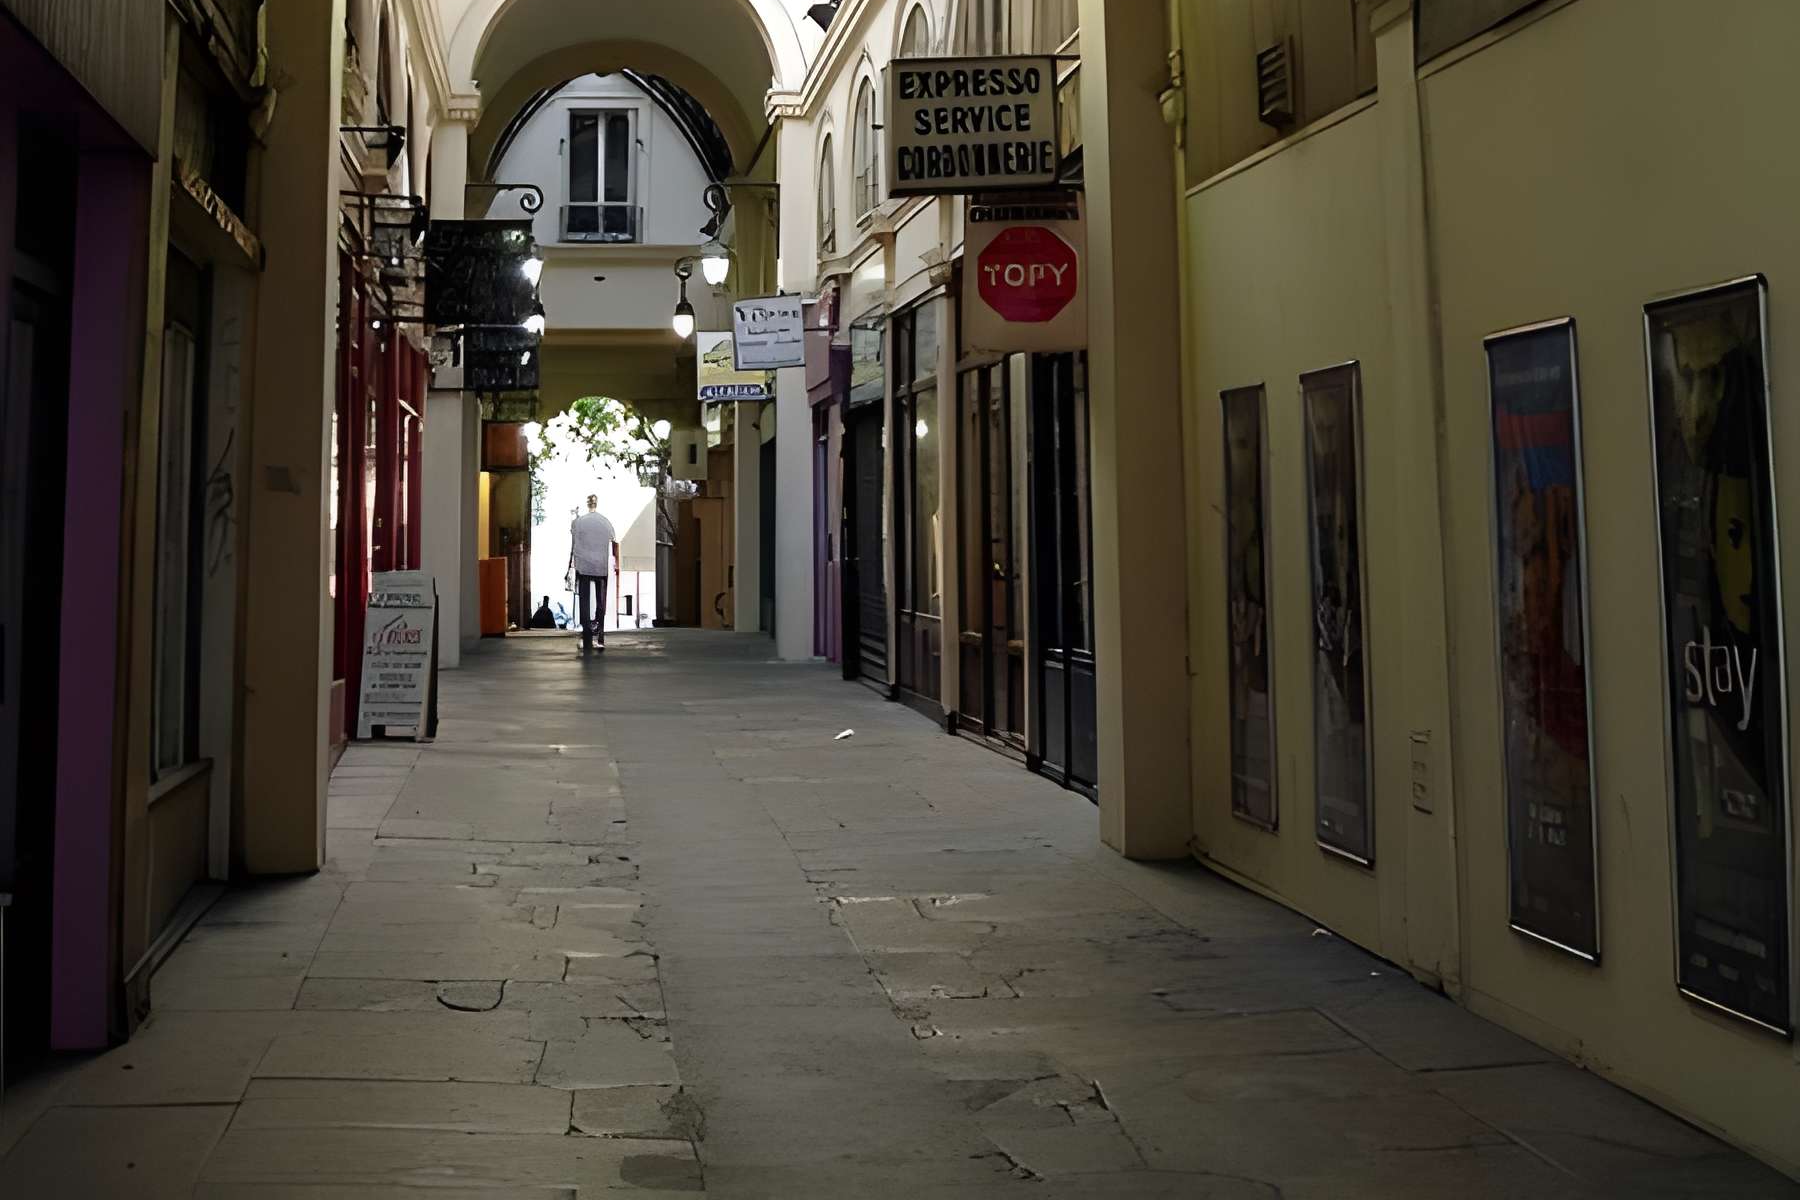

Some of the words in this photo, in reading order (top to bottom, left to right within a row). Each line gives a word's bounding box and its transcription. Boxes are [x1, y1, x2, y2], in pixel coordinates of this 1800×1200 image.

[899, 67, 1041, 100] EXPRESSO
[914, 103, 1031, 136] SERVICE
[983, 262, 1069, 287] TOPY
[1684, 624, 1758, 731] stay
